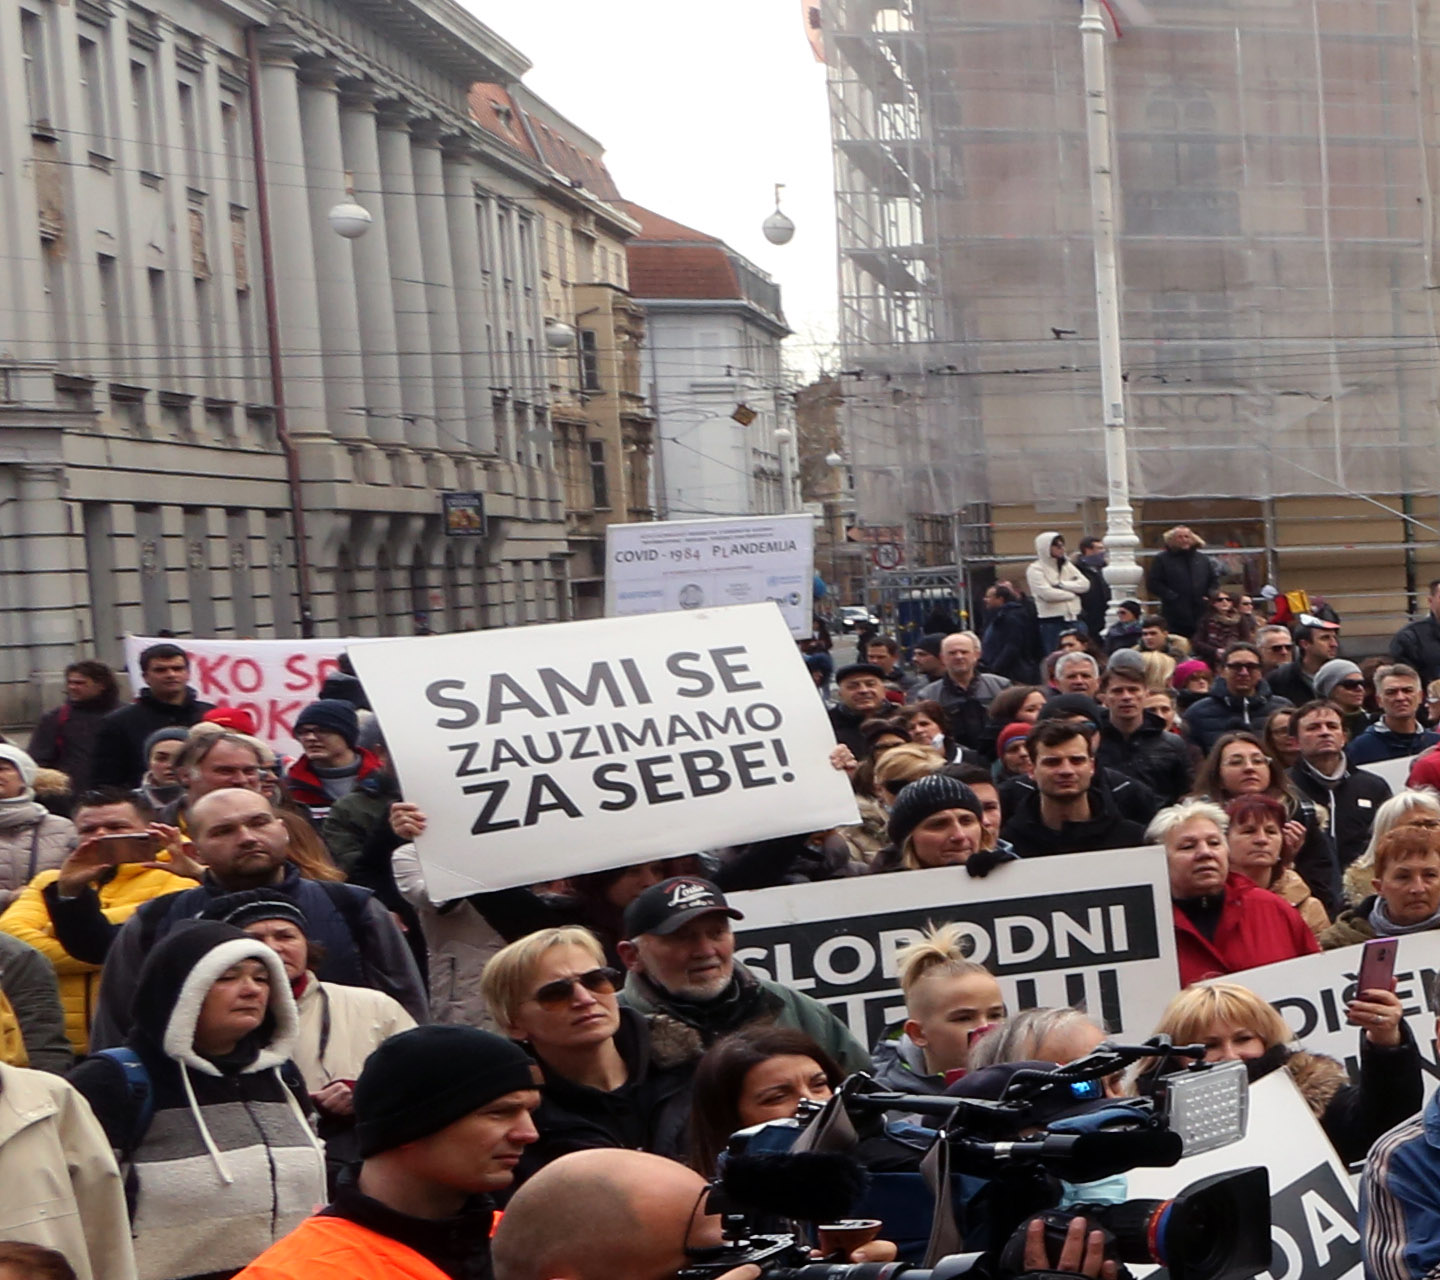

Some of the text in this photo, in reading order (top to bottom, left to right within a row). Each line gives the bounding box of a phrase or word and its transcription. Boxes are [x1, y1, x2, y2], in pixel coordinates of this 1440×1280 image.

[614, 549, 659, 564] COVID
[670, 547, 701, 562] 1984
[425, 645, 764, 730] SAMI SE
[447, 702, 783, 778] ZAUZIMAMO
[461, 738, 796, 836] ZA SEBE!
